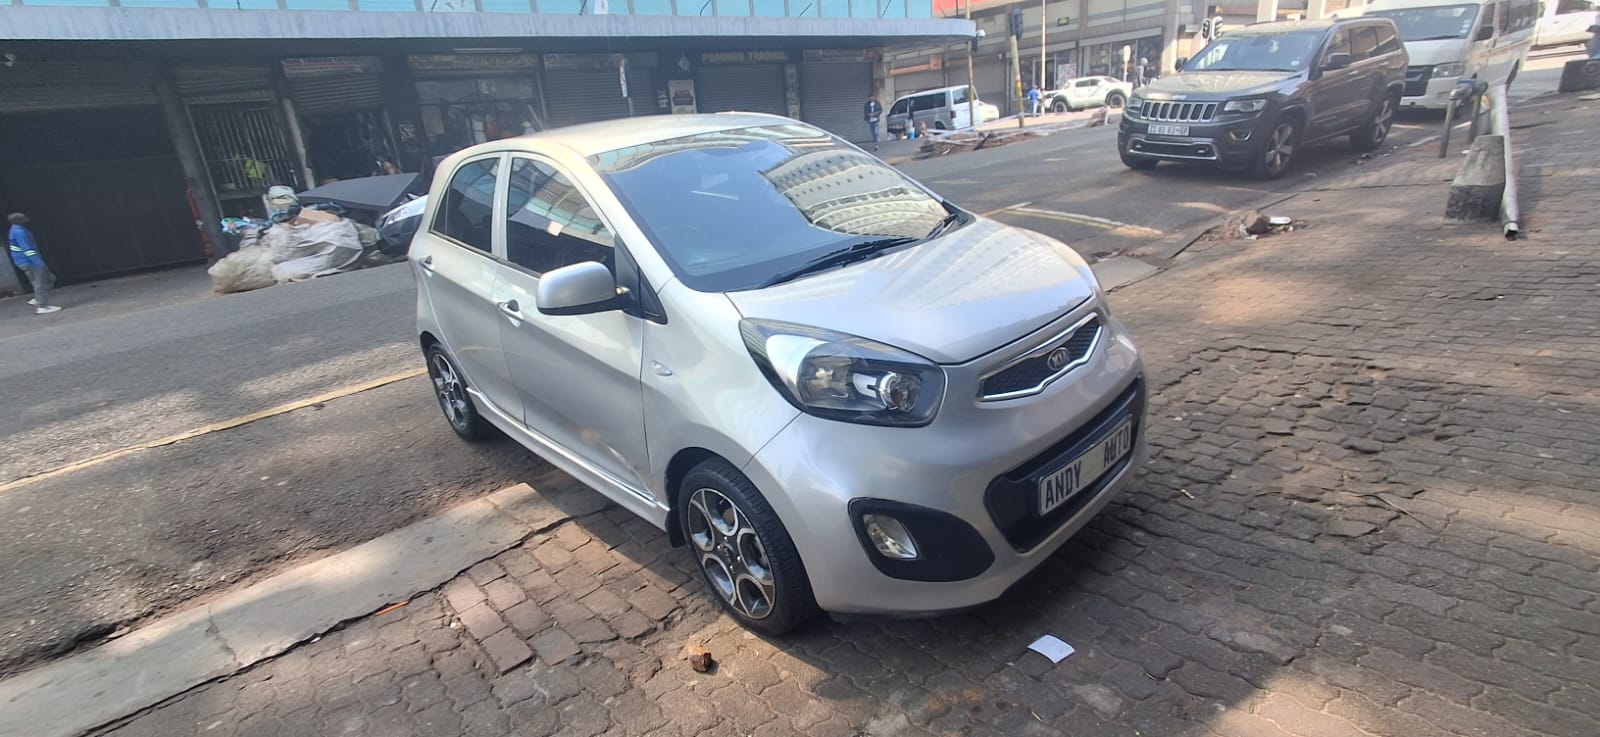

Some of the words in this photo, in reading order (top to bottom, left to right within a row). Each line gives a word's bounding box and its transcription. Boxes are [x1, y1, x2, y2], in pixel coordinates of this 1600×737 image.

[1051, 351, 1069, 368] KIA
[1045, 460, 1082, 509] ANDY
[1104, 425, 1129, 468] AUTO
